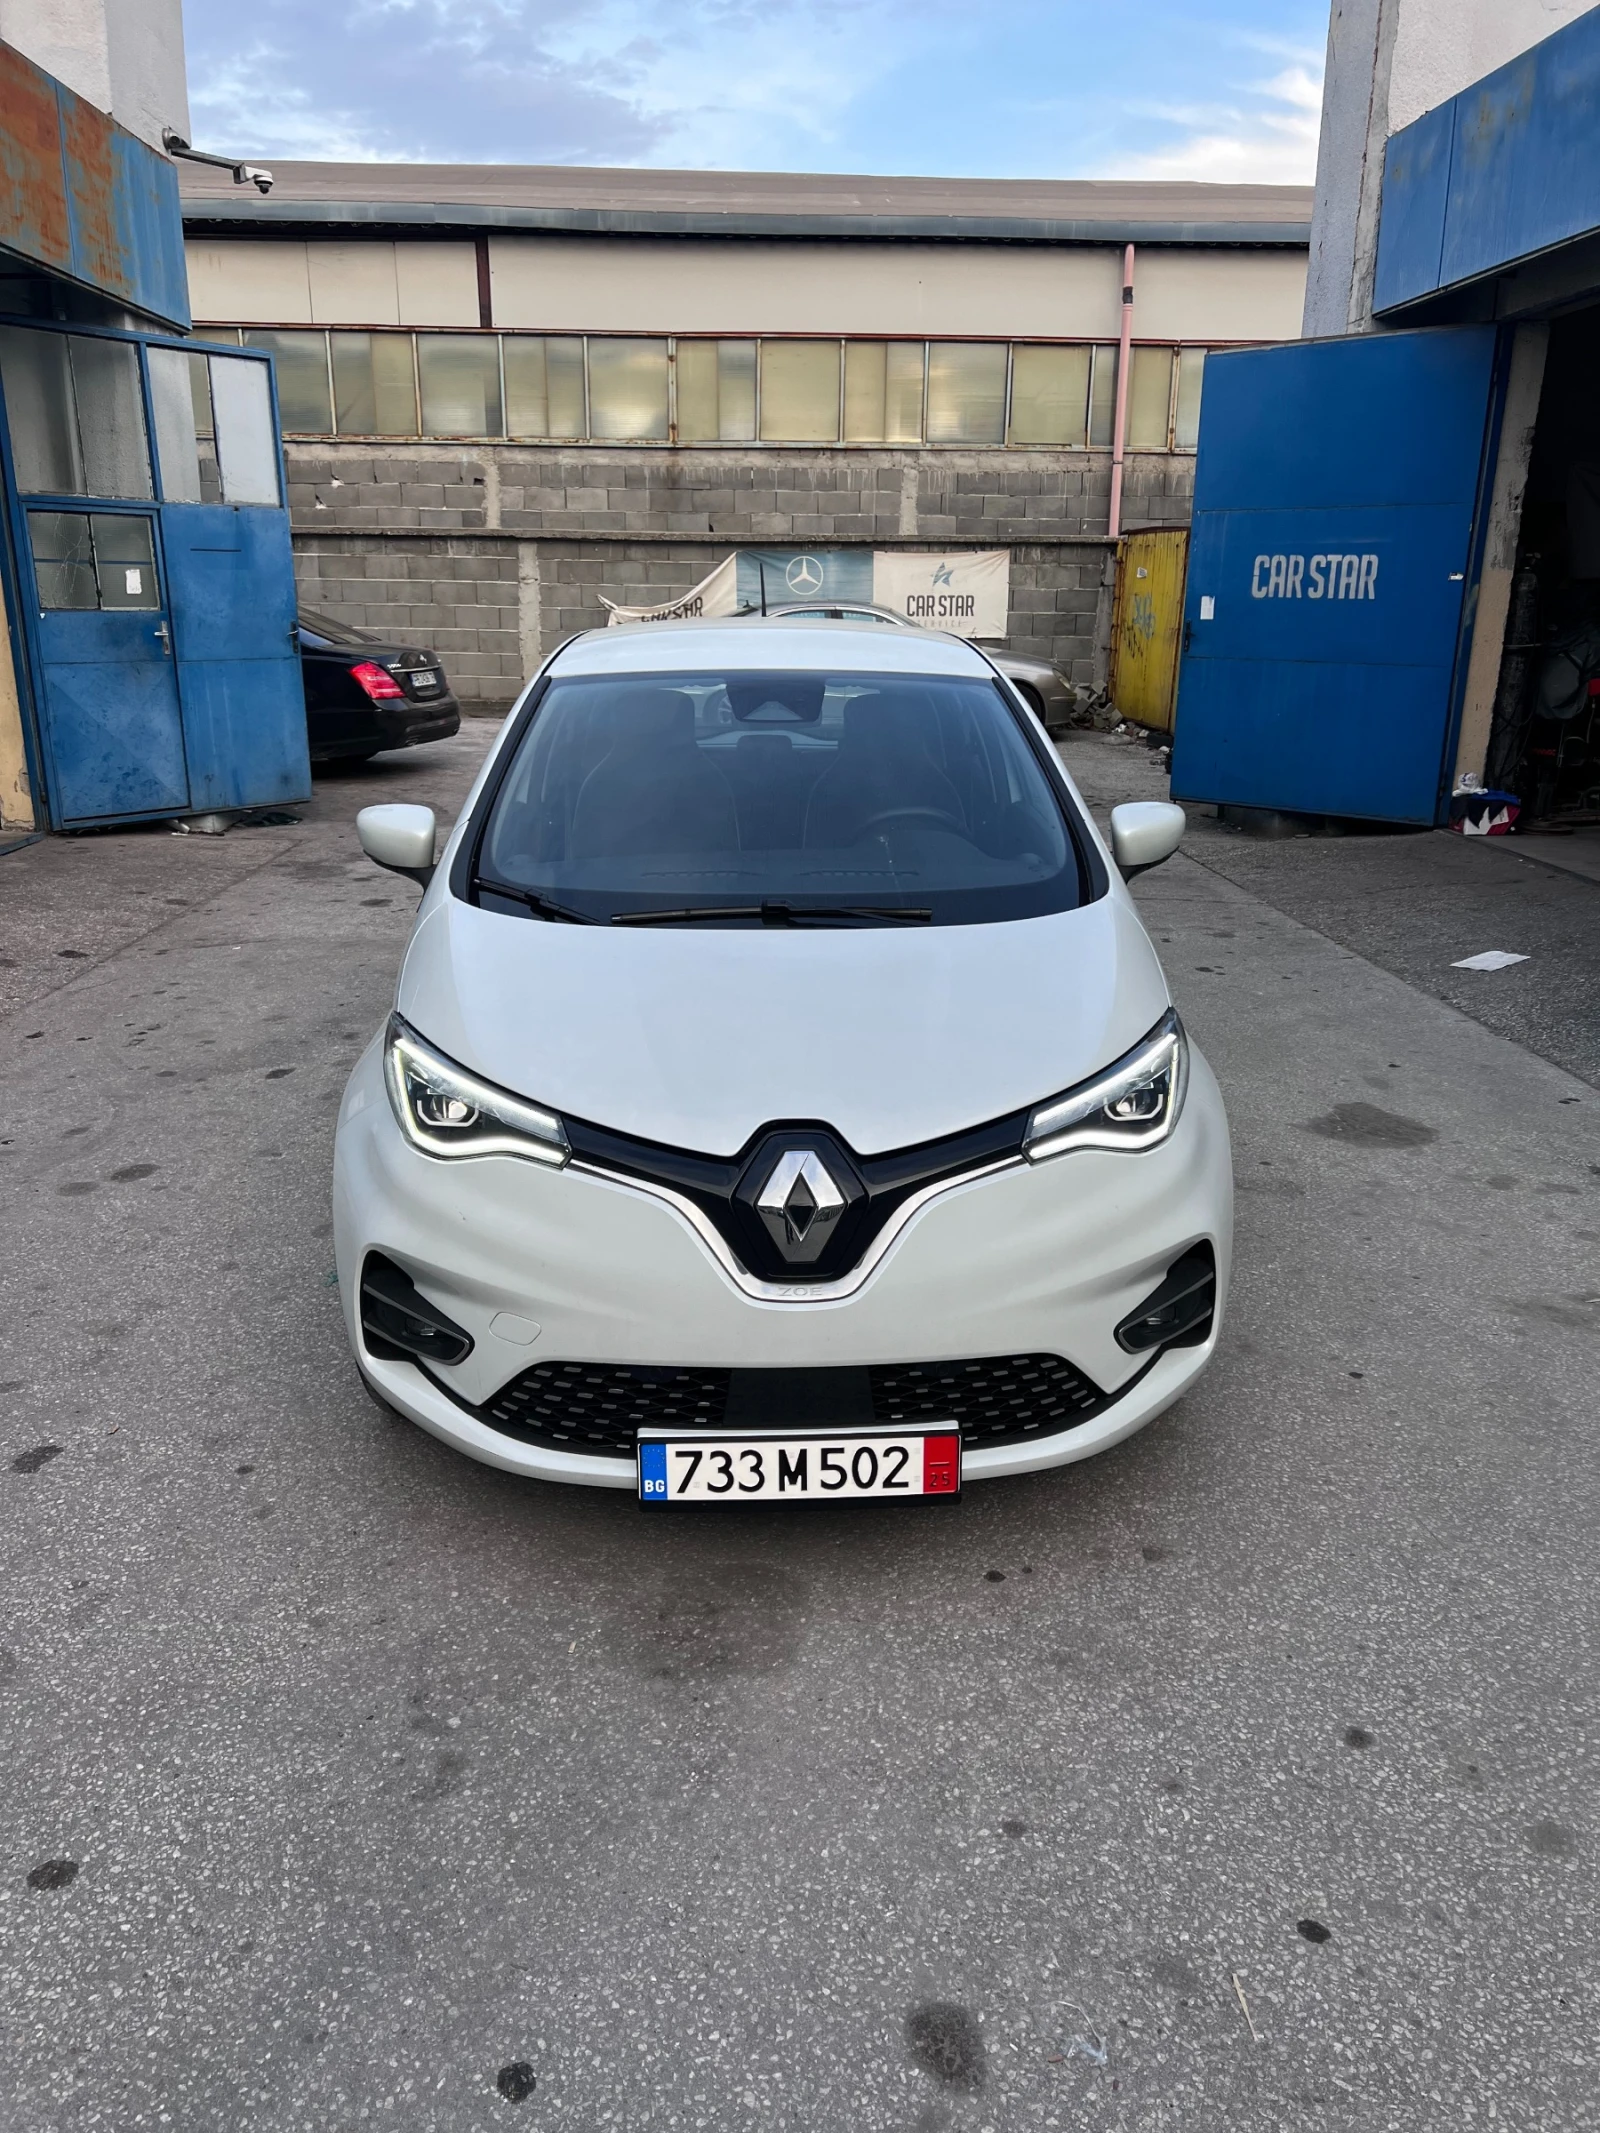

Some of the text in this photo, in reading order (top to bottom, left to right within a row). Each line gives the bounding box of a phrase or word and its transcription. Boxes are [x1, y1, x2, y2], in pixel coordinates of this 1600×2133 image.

[1251, 554, 1379, 600] CAR STAR
[906, 594, 975, 617] CAR STAR
[777, 1286, 823, 1297] ZOE
[675, 1450, 766, 1494] 733
[820, 1445, 910, 1490] 502
[644, 1479, 665, 1493] BG
